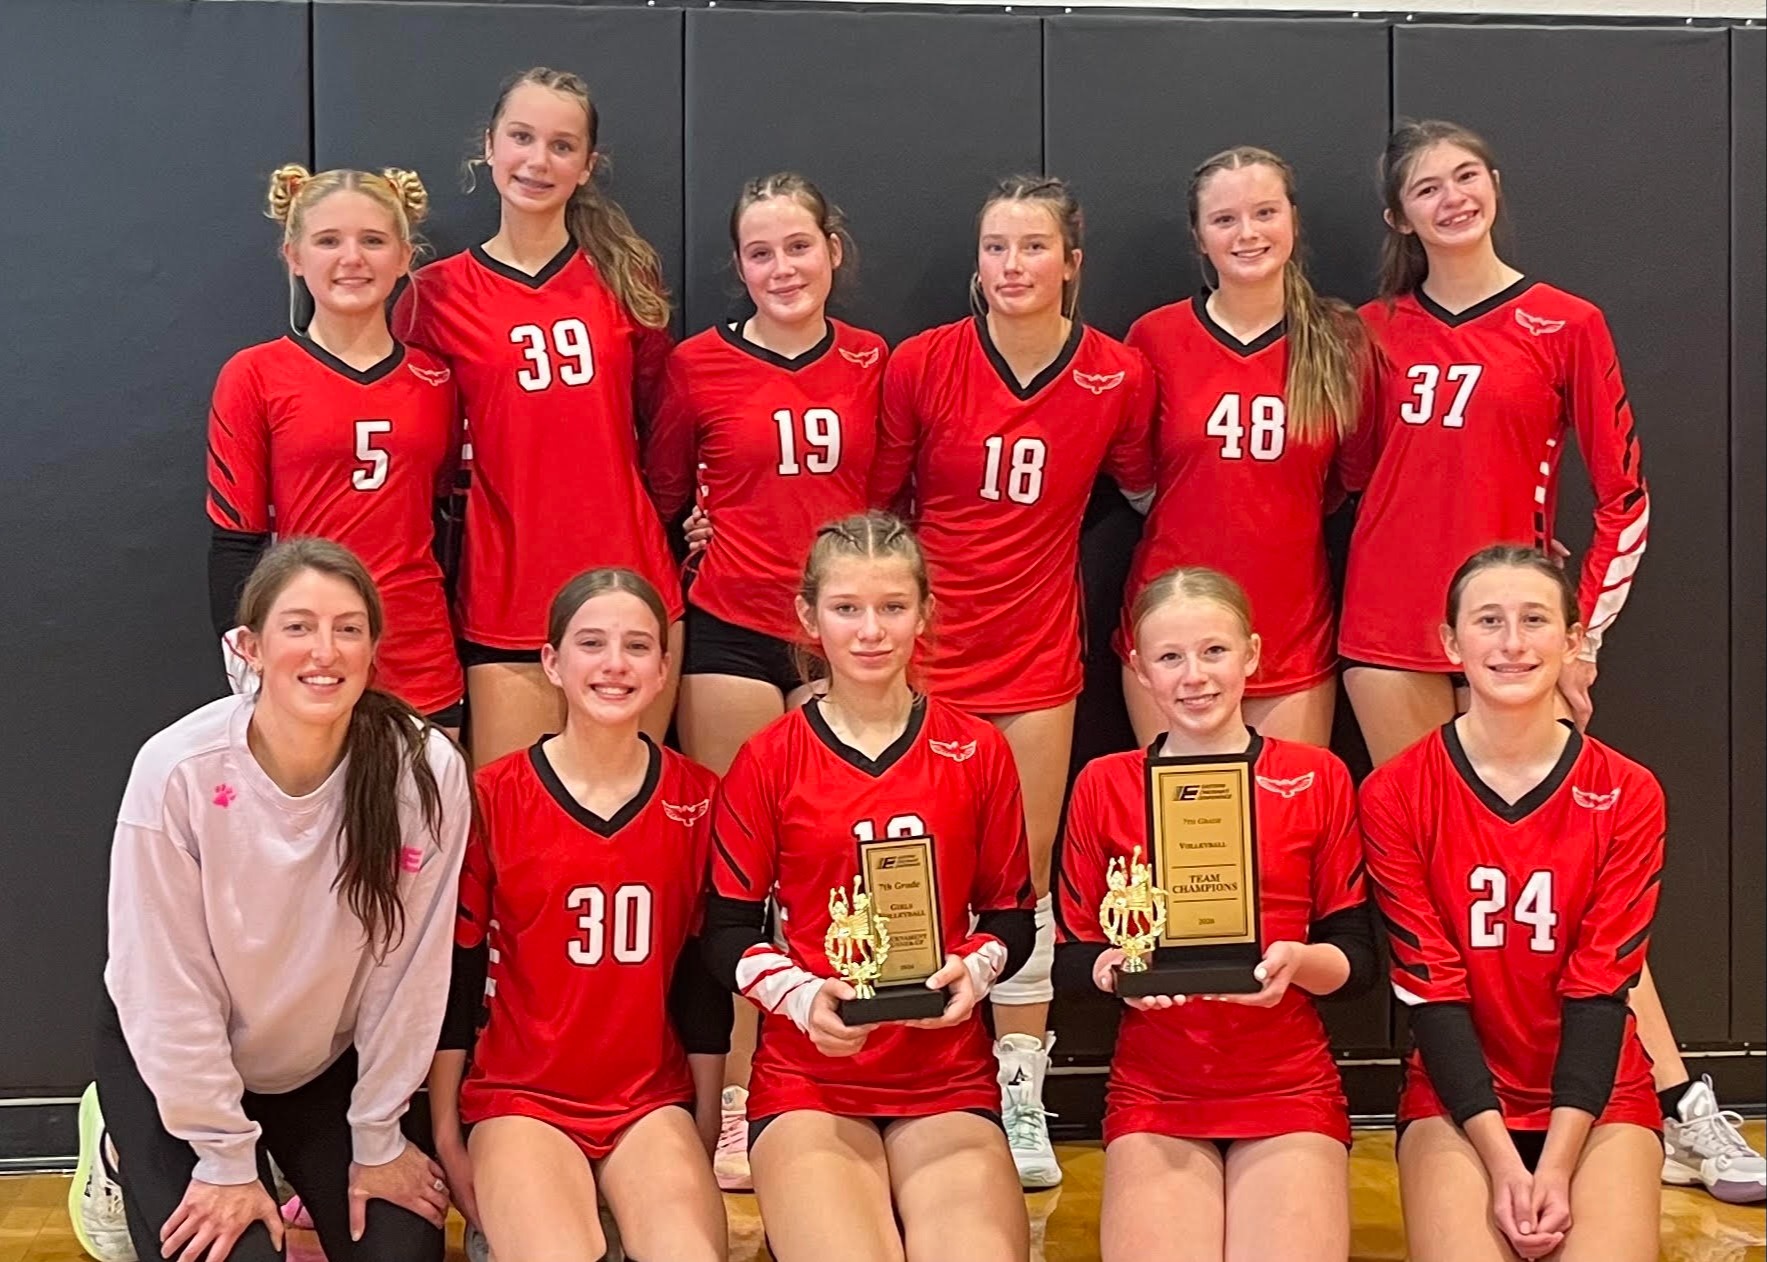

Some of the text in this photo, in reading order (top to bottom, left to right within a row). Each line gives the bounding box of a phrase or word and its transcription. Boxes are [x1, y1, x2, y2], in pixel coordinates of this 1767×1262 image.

[509, 318, 595, 392] 39
[1206, 393, 1286, 461] 48
[1400, 363, 1483, 428] 37
[351, 419, 392, 491] 5
[772, 407, 841, 476] 19
[979, 435, 1046, 505] 18
[894, 881, 920, 890] Grade
[1172, 882, 1238, 894] CHAMPIONS
[1189, 874, 1220, 883] TEAM
[1469, 865, 1558, 952] 24
[567, 884, 653, 966] 30
